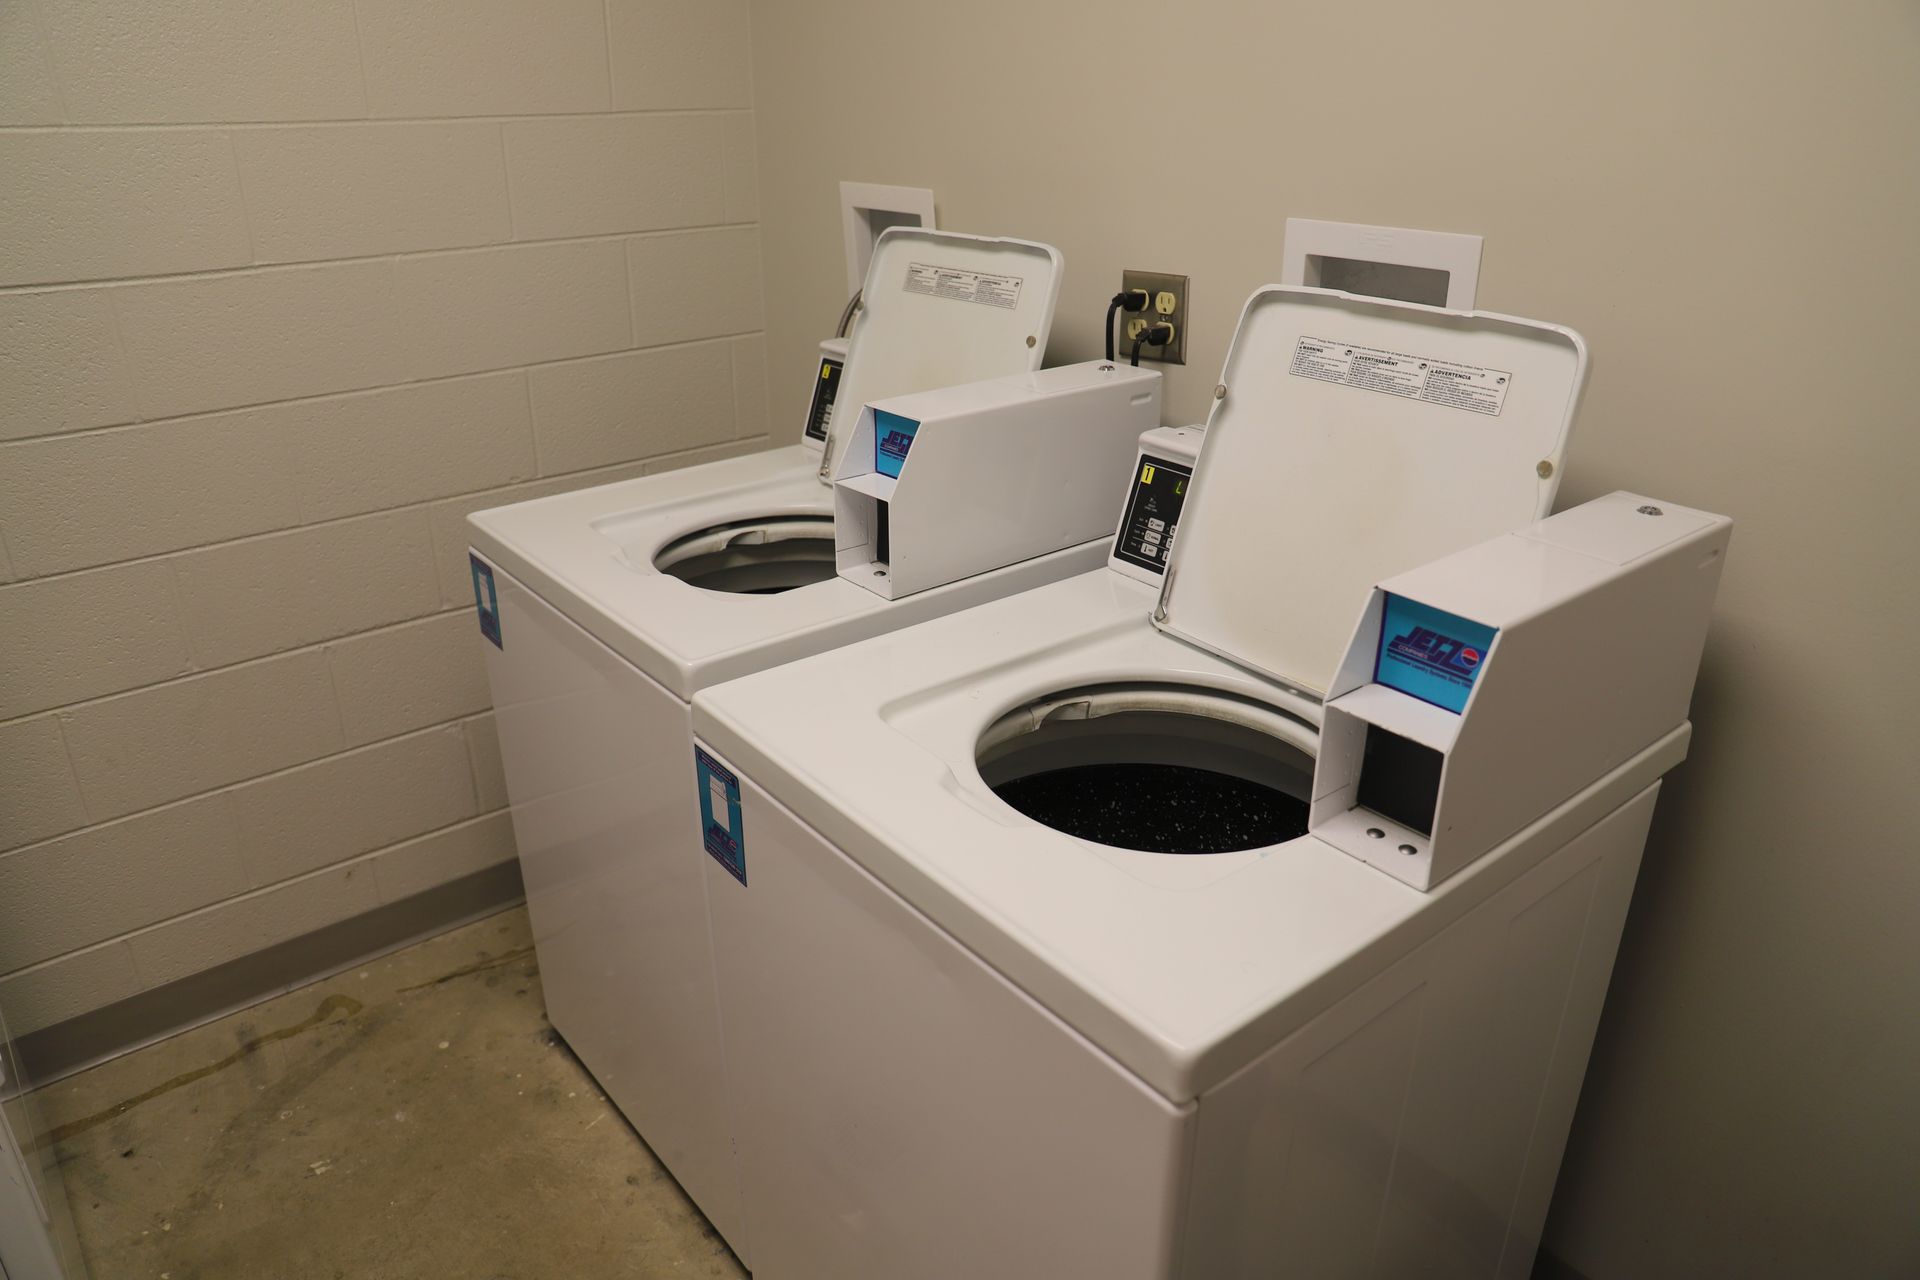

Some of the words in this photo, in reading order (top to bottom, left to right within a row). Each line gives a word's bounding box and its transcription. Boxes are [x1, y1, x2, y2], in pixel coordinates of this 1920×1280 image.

[1302, 345, 1324, 354] WARNING
[1358, 355, 1399, 367] AVERTISSEMENT
[1434, 369, 1472, 381] ADVERTENCIA
[1145, 467, 1151, 481] 1
